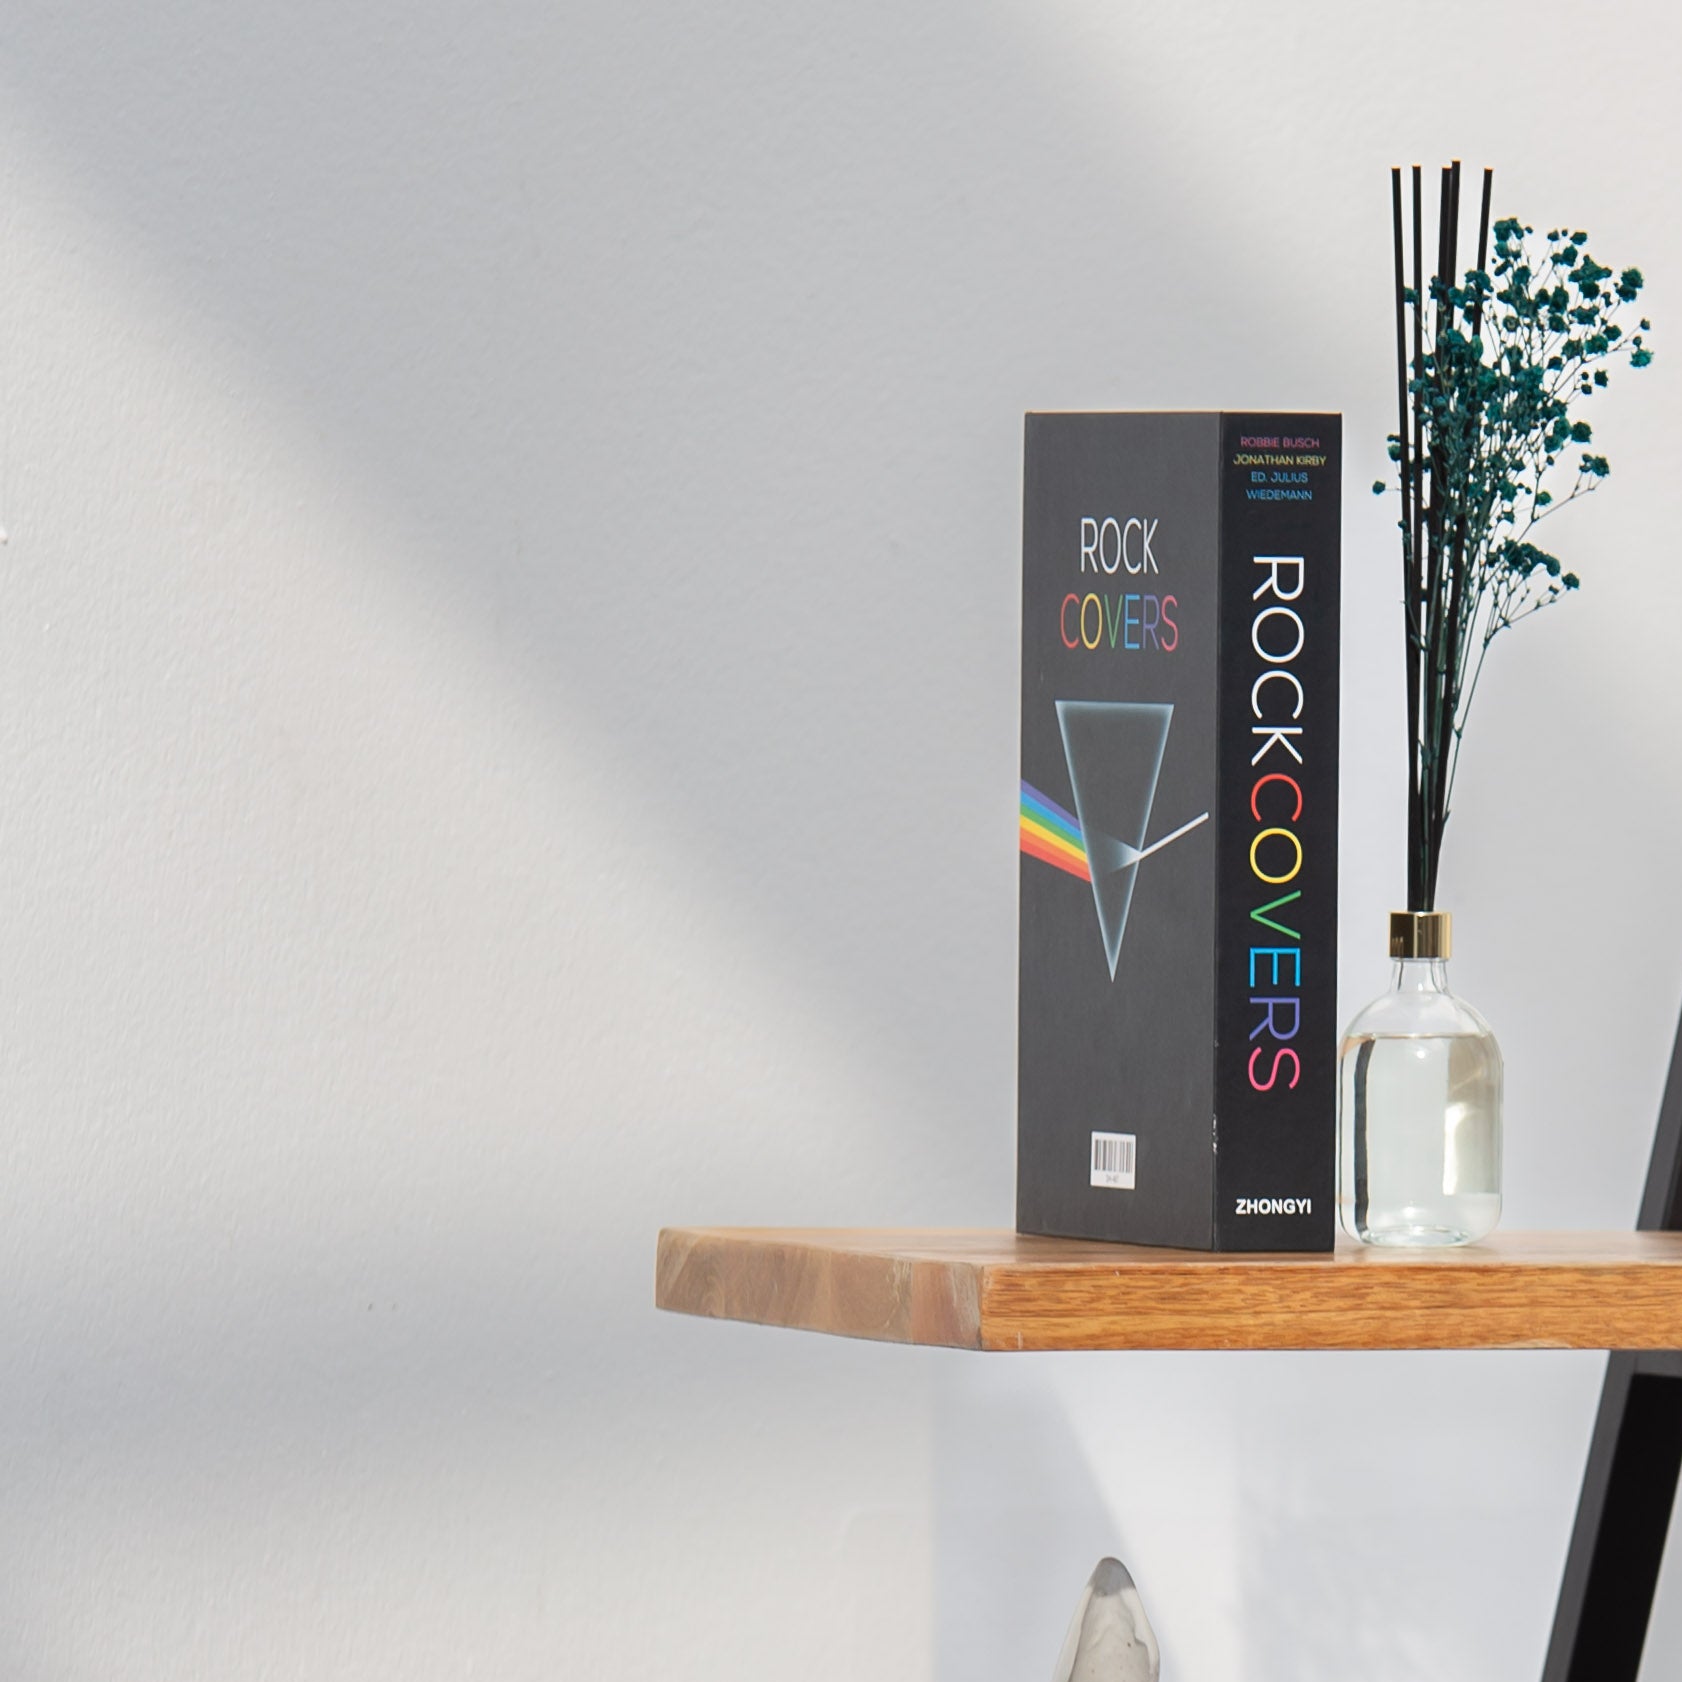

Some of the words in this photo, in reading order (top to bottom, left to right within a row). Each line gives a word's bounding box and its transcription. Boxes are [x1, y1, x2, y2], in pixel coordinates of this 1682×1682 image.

[1240, 436, 1280, 448] ROBBIE
[1282, 437, 1320, 449] BUSCH
[1232, 453, 1295, 466] JONATHAN
[1296, 455, 1327, 466] KIRBY
[1270, 472, 1309, 483] JULIUS
[1246, 488, 1313, 501] WIEDEMANN
[1080, 517, 1159, 574] ROCK
[1060, 592, 1179, 652] COVERS
[1235, 1198, 1312, 1216] ZHONGYI
